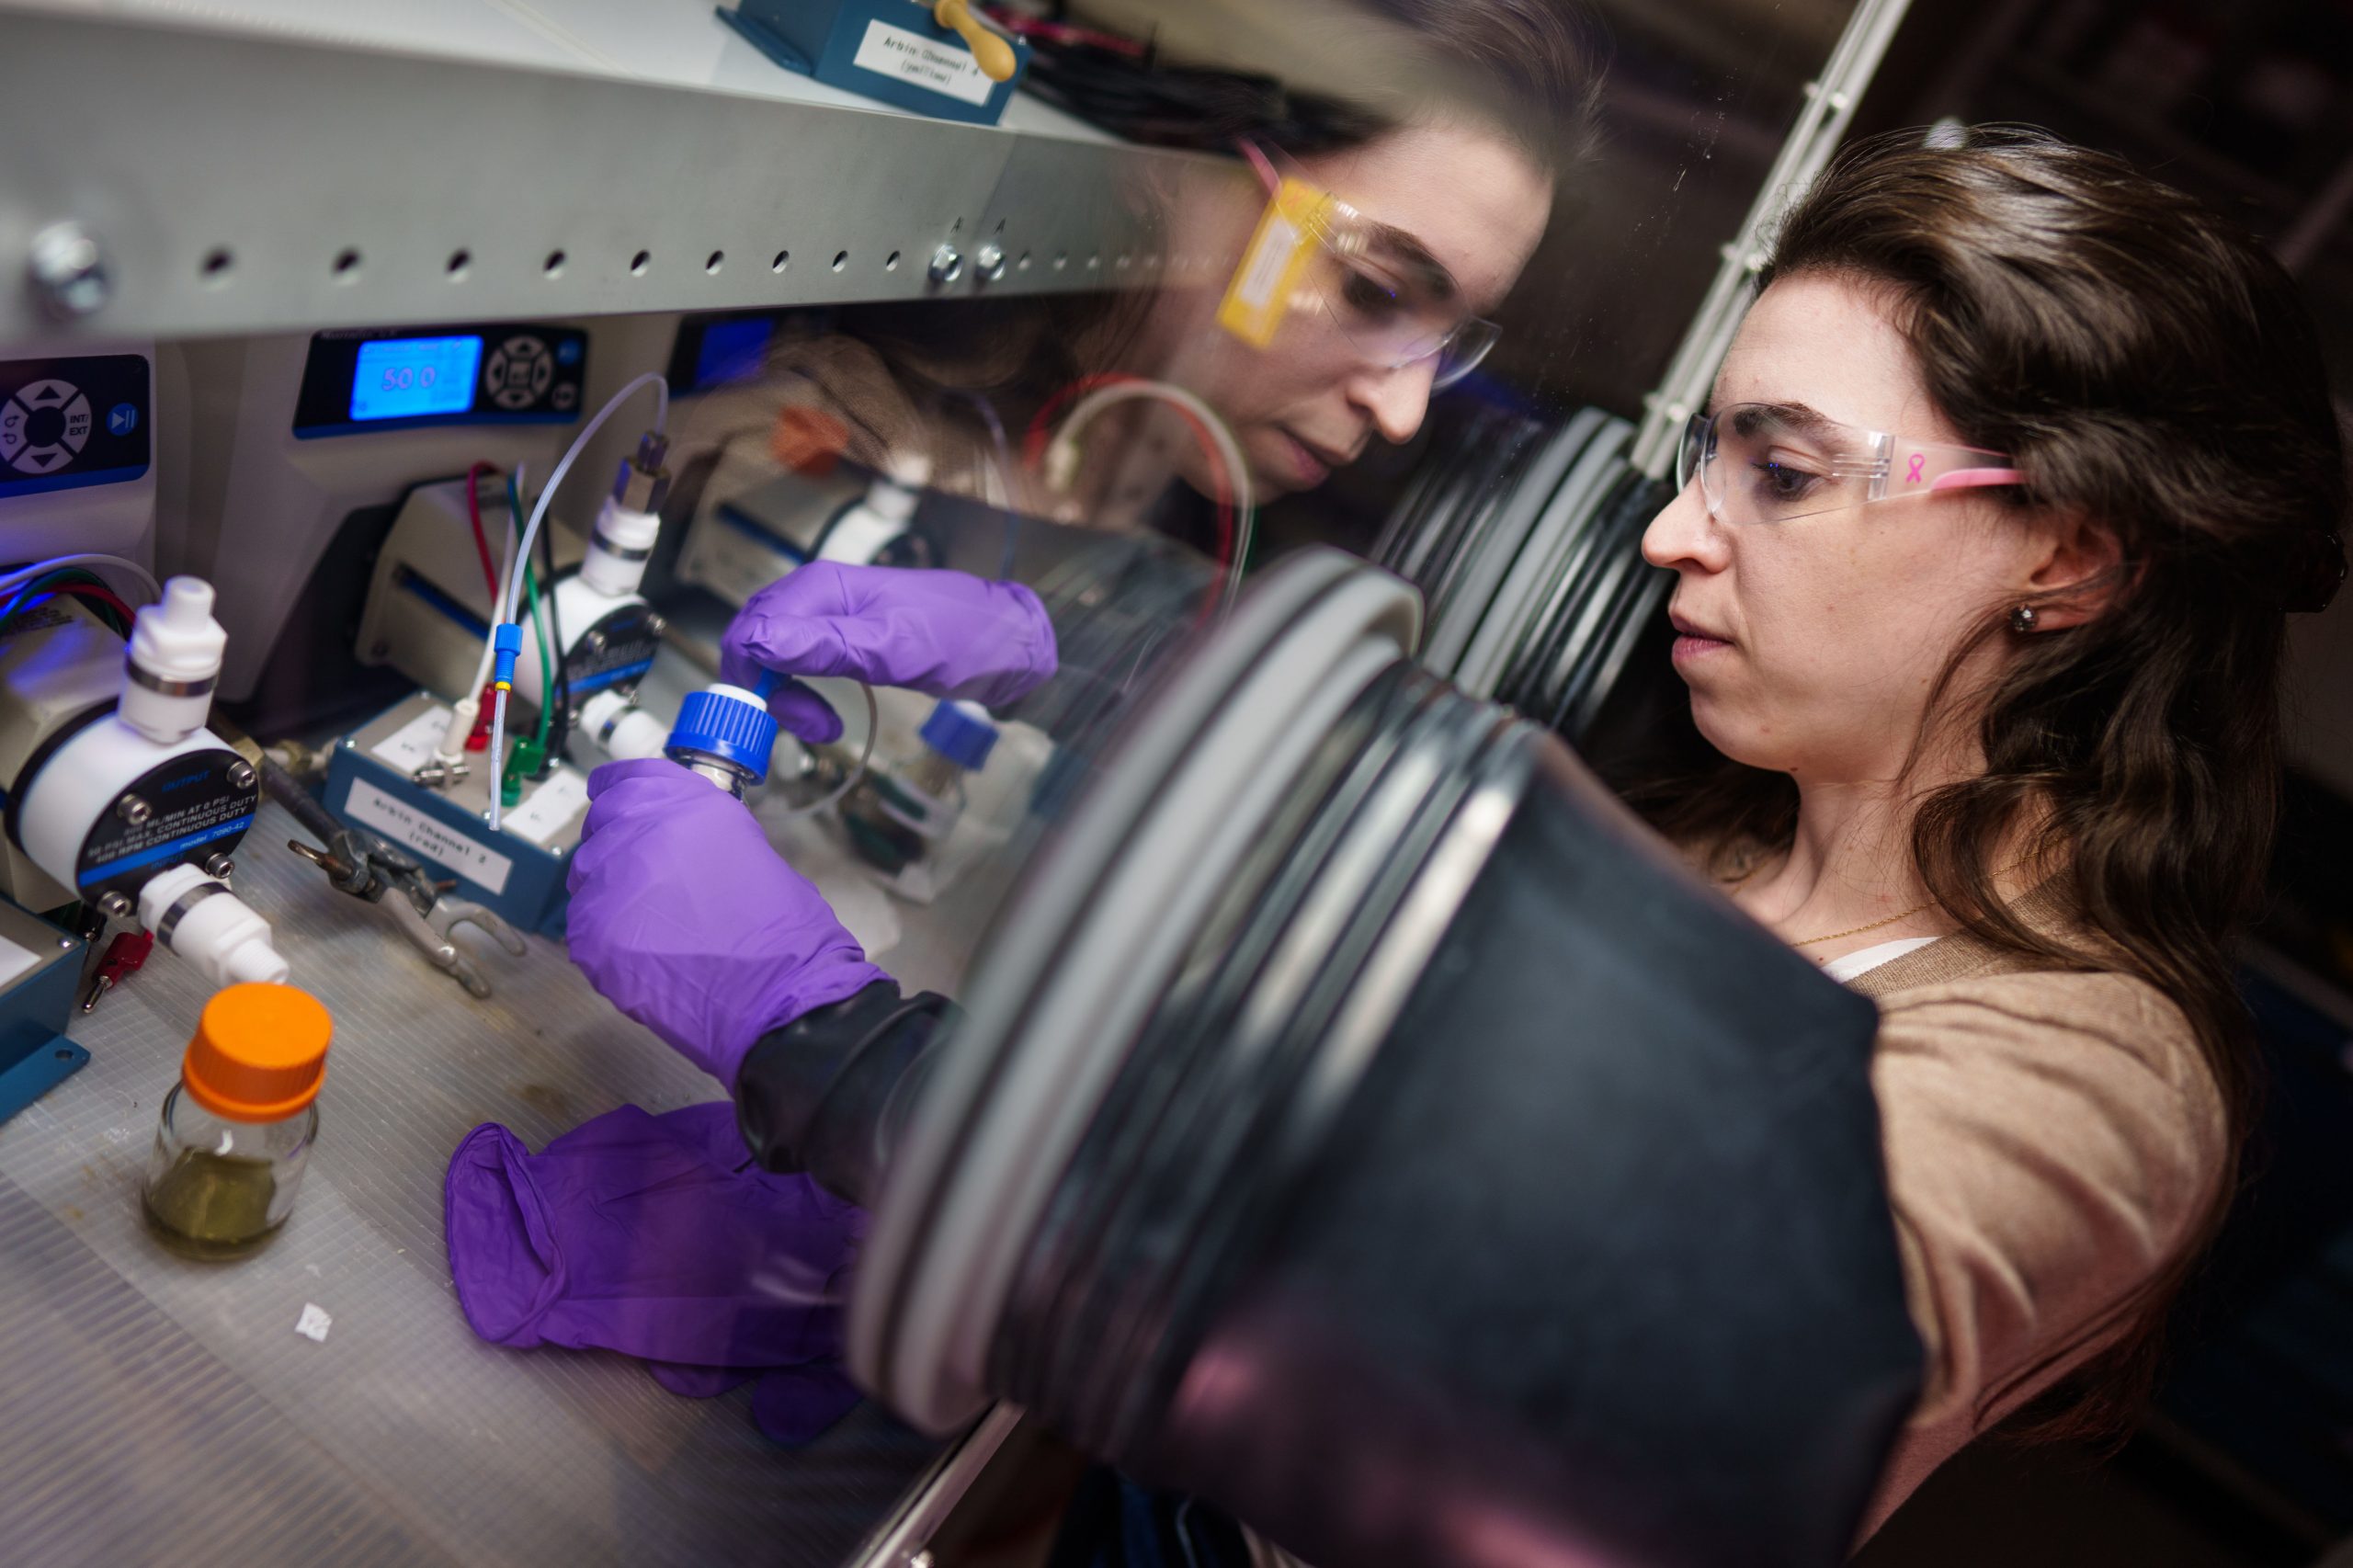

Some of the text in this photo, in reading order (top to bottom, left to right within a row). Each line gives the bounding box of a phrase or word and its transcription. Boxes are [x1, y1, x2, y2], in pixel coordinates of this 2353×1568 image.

[69, 426, 88, 437] EXT
[162, 770, 210, 792] OUTPUT
[146, 808, 186, 828] ML/MIN
[188, 802, 203, 815] AT
[212, 795, 231, 807] PSI
[157, 804, 227, 835] CONTINUOUS
[229, 794, 257, 809] DUTY
[118, 842, 144, 857] RPM
[146, 815, 217, 846] CONTINUOUS
[219, 805, 248, 821] DUTY
[179, 835, 208, 850] model
[419, 822, 471, 856] Channel
[150, 853, 185, 871] INPUT
